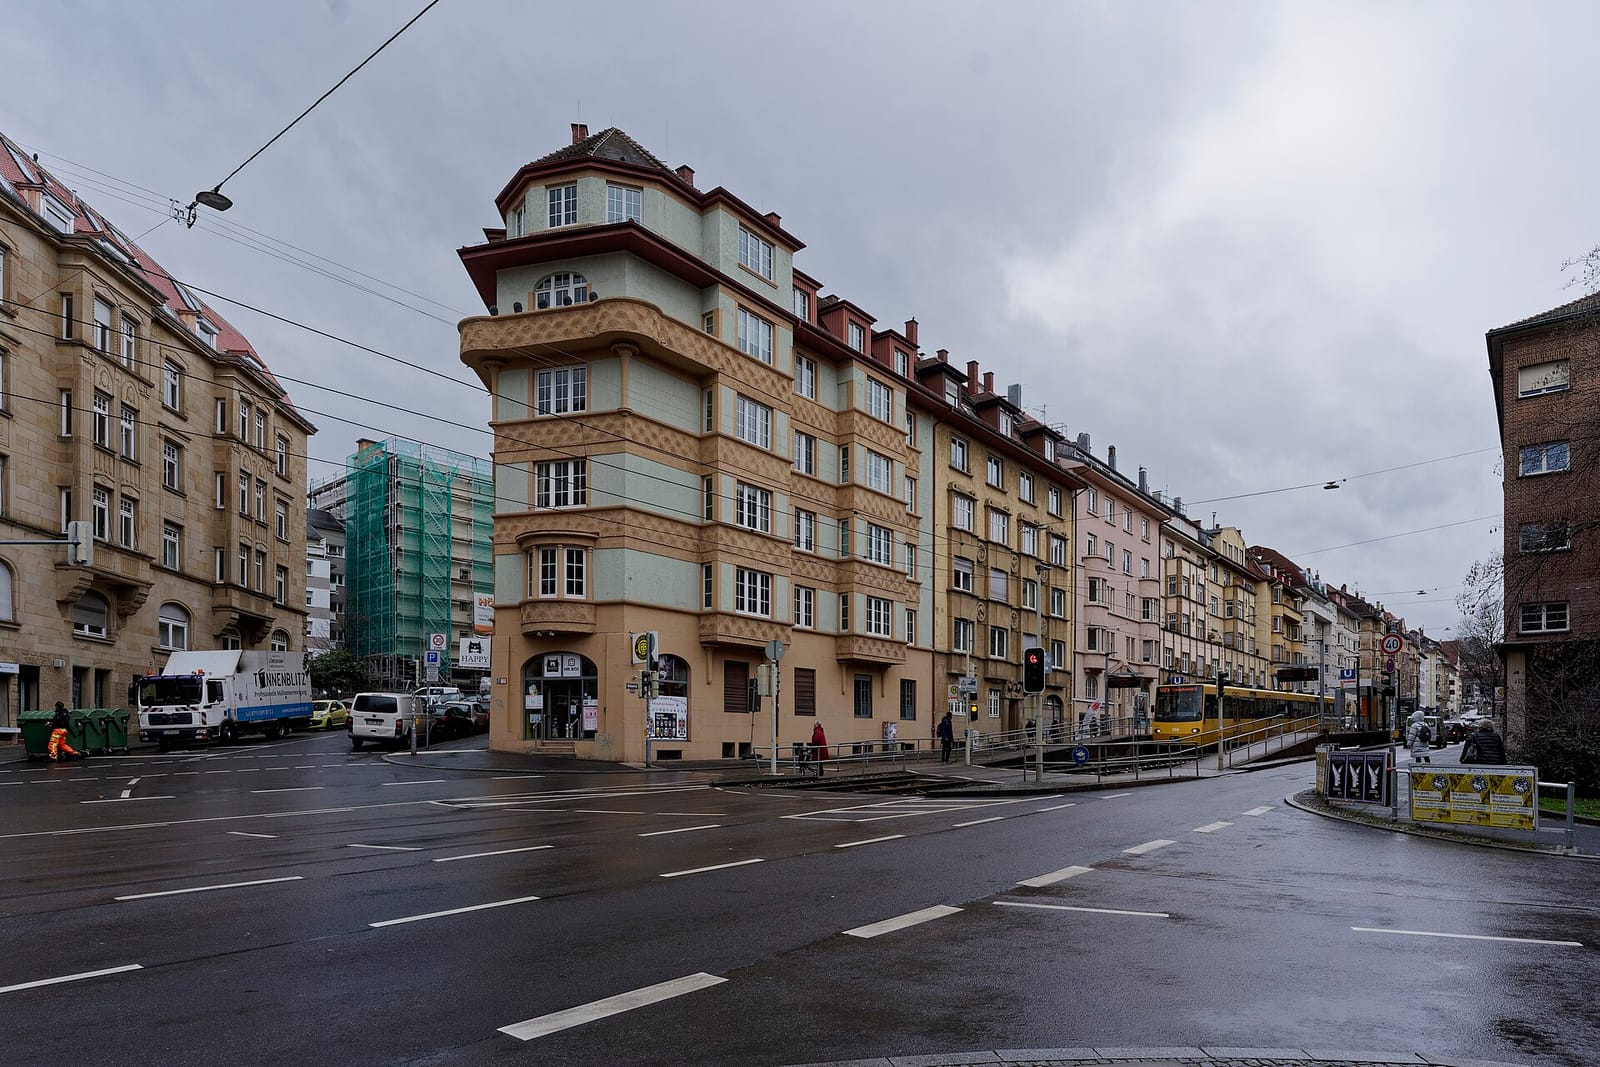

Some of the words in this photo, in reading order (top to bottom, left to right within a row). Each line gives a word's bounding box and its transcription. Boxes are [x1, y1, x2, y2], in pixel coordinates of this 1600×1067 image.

[1385, 639, 1399, 650] 40
[429, 653, 436, 662] P
[461, 655, 489, 663] HAPPY
[1343, 669, 1352, 677] U
